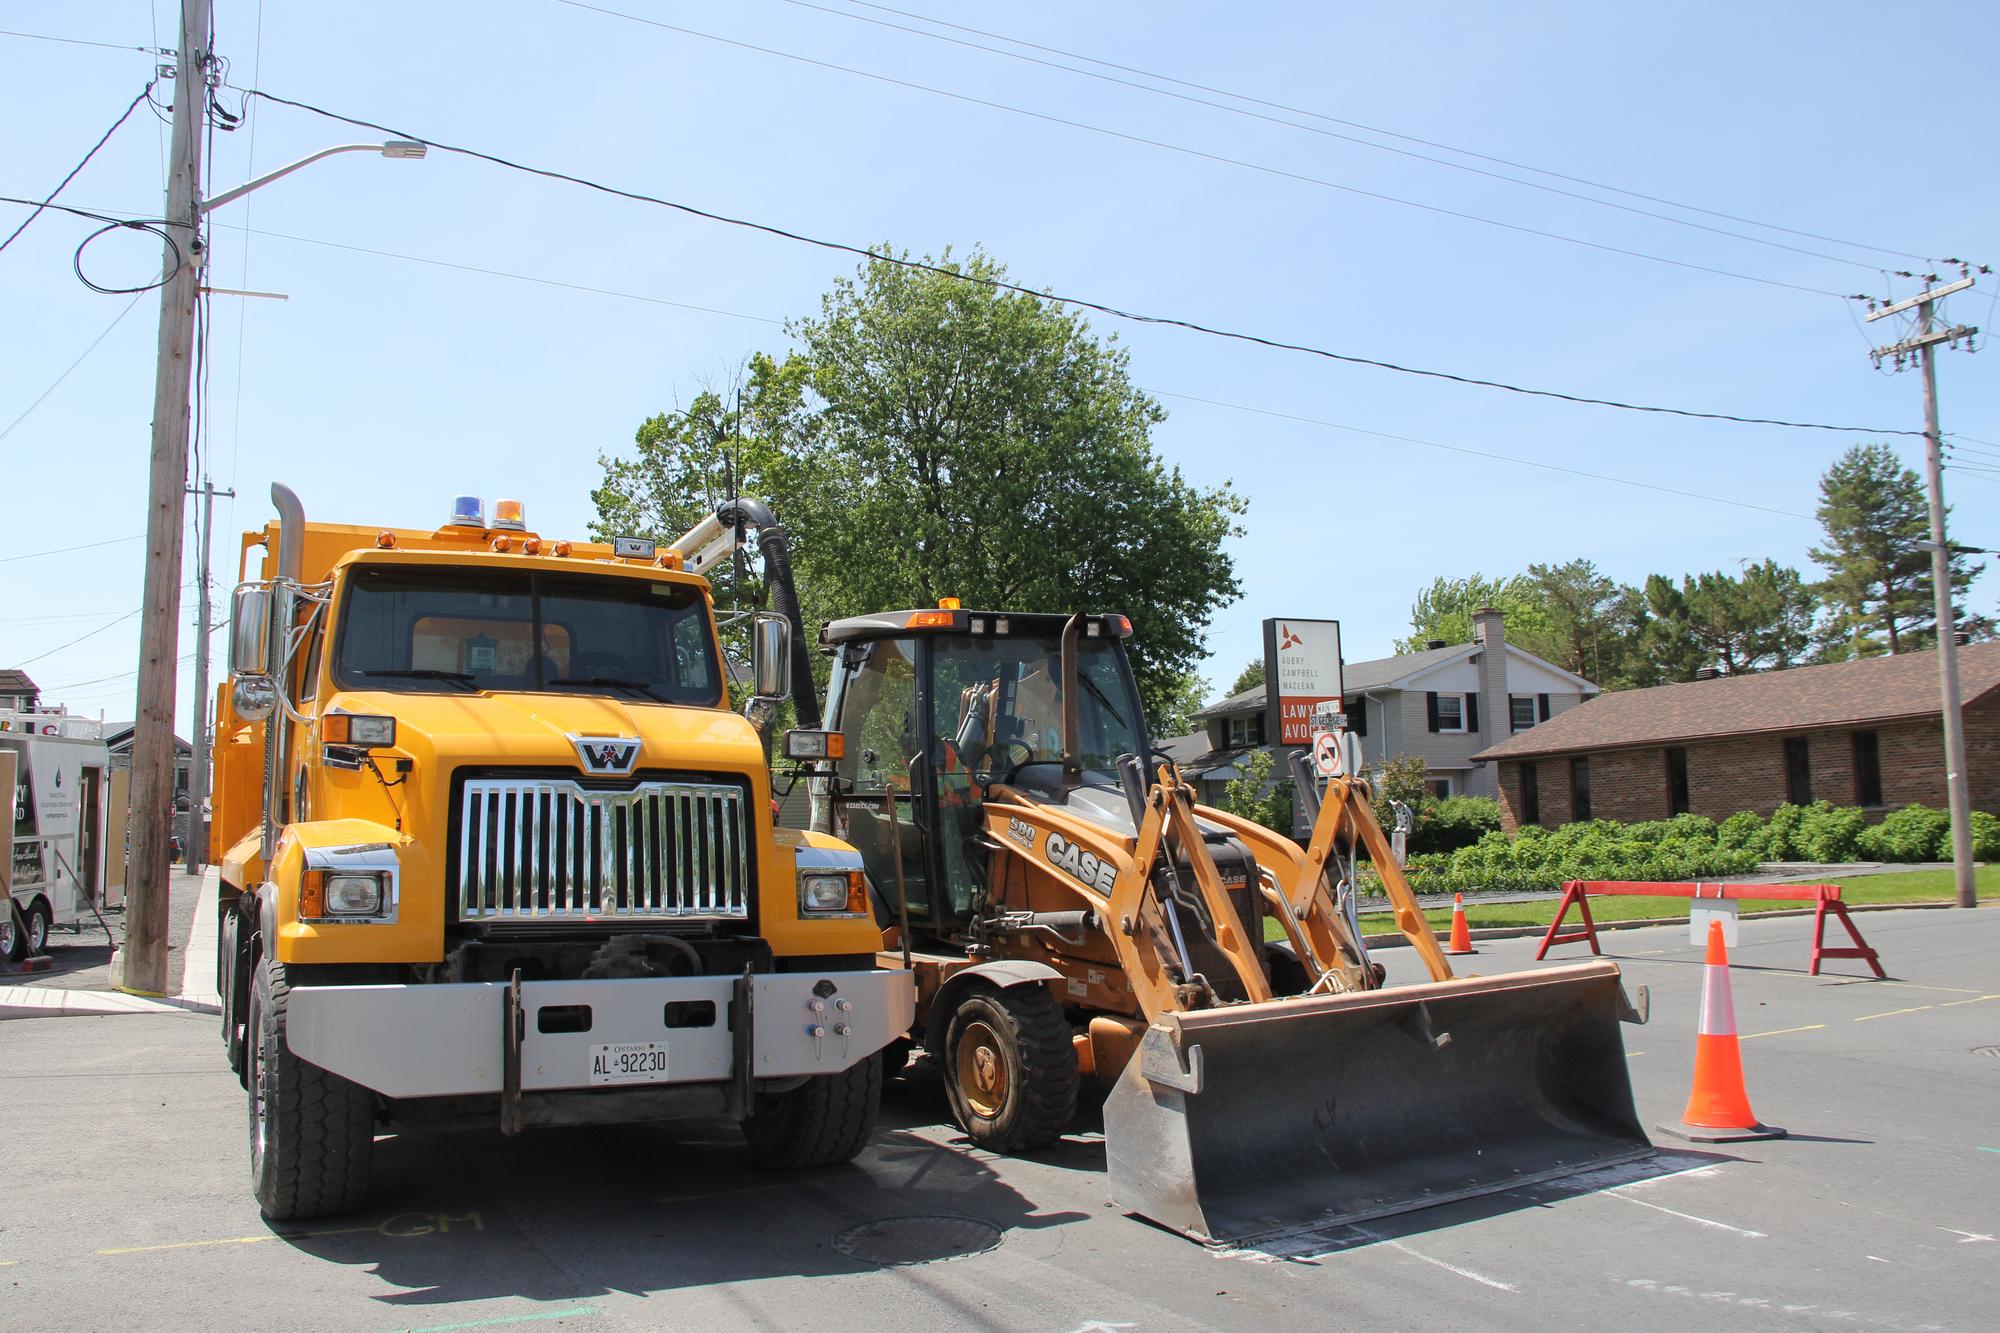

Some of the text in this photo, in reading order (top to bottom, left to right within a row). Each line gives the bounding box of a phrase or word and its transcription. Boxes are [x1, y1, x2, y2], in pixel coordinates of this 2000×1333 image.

[1282, 669, 1319, 678] CAMPBELL
[1283, 681, 1315, 690] MACLEAN
[1008, 815, 1036, 841] 580
[1045, 831, 1118, 899] CASE
[593, 1051, 666, 1075] AL 92230
